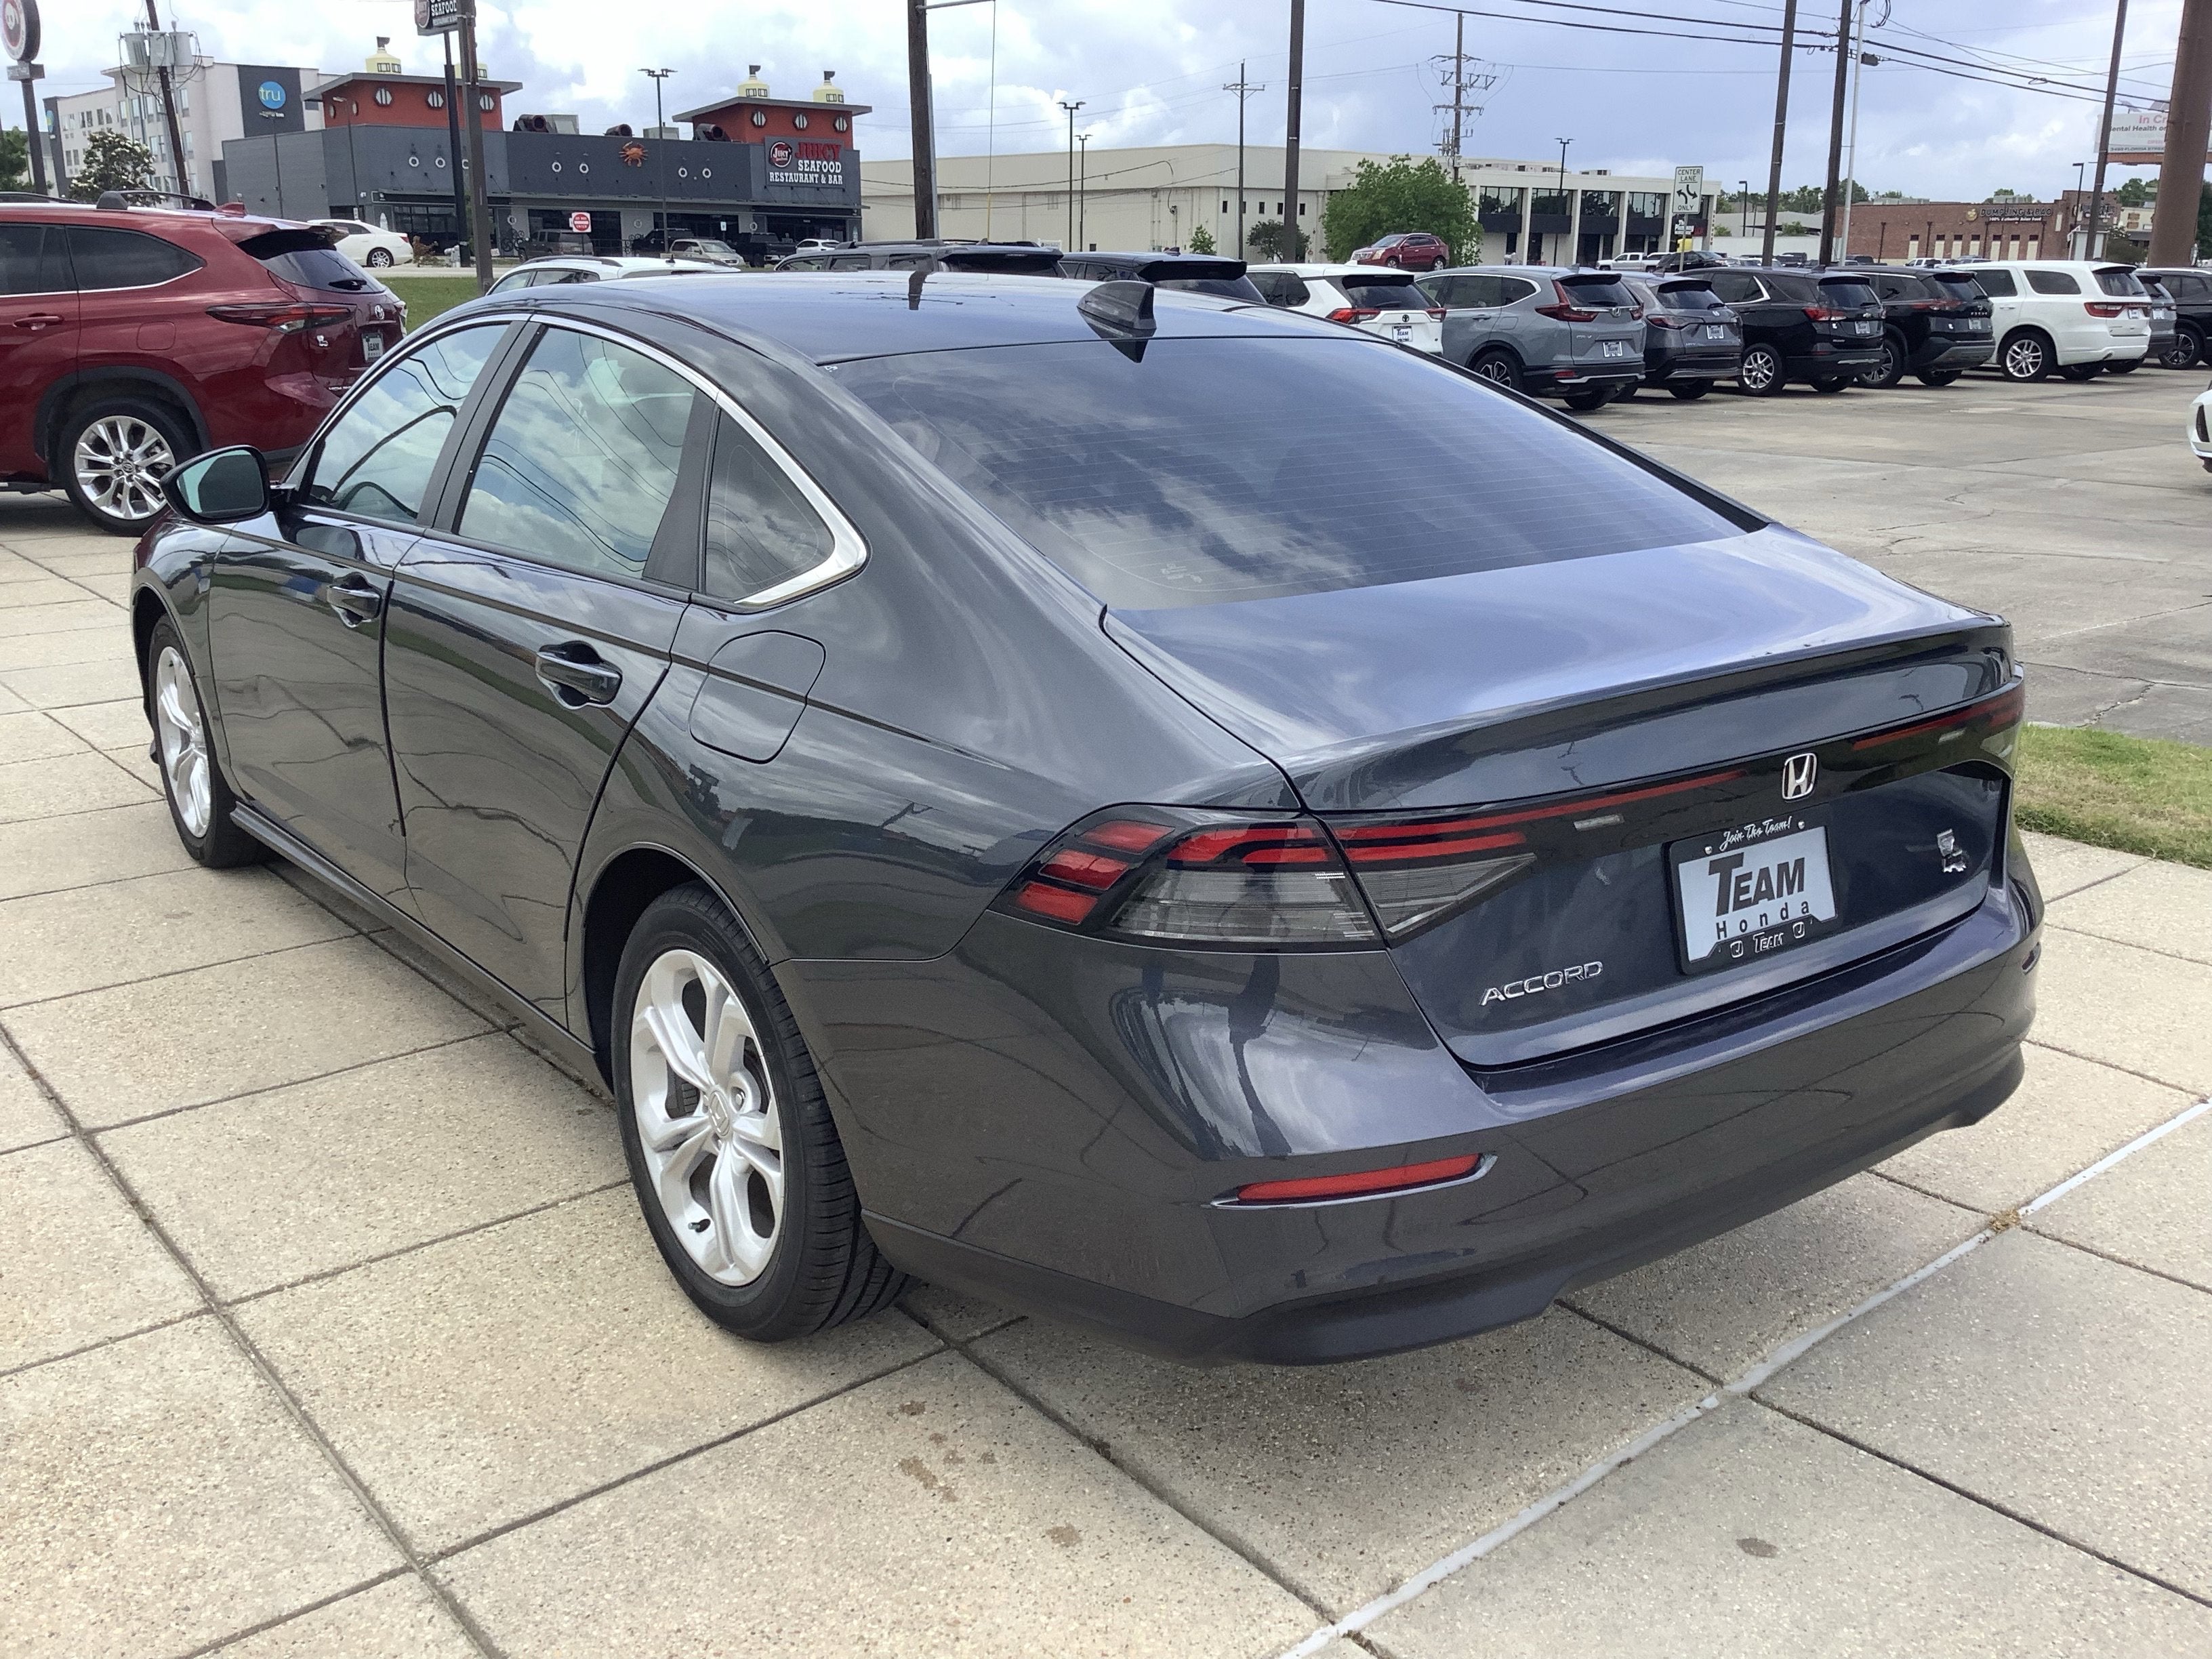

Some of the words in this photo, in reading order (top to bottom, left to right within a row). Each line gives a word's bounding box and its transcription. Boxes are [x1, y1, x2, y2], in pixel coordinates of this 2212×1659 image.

[259, 87, 281, 101] tru
[2139, 115, 2150, 123] In
[2153, 115, 2168, 123] Cr
[794, 142, 841, 161] JUICY
[798, 159, 842, 173] SEAFOOD
[769, 171, 819, 184] RESTAURANT
[821, 173, 827, 184] &
[828, 174, 843, 185] BAR
[1719, 830, 1744, 851] Join
[1744, 823, 1763, 840] The
[1762, 815, 1793, 836] Team!
[1708, 852, 1805, 917] TEAM
[1716, 901, 1809, 940] Honda
[1753, 932, 1784, 953] TEAM
[1479, 961, 1603, 1006] ACCORD
